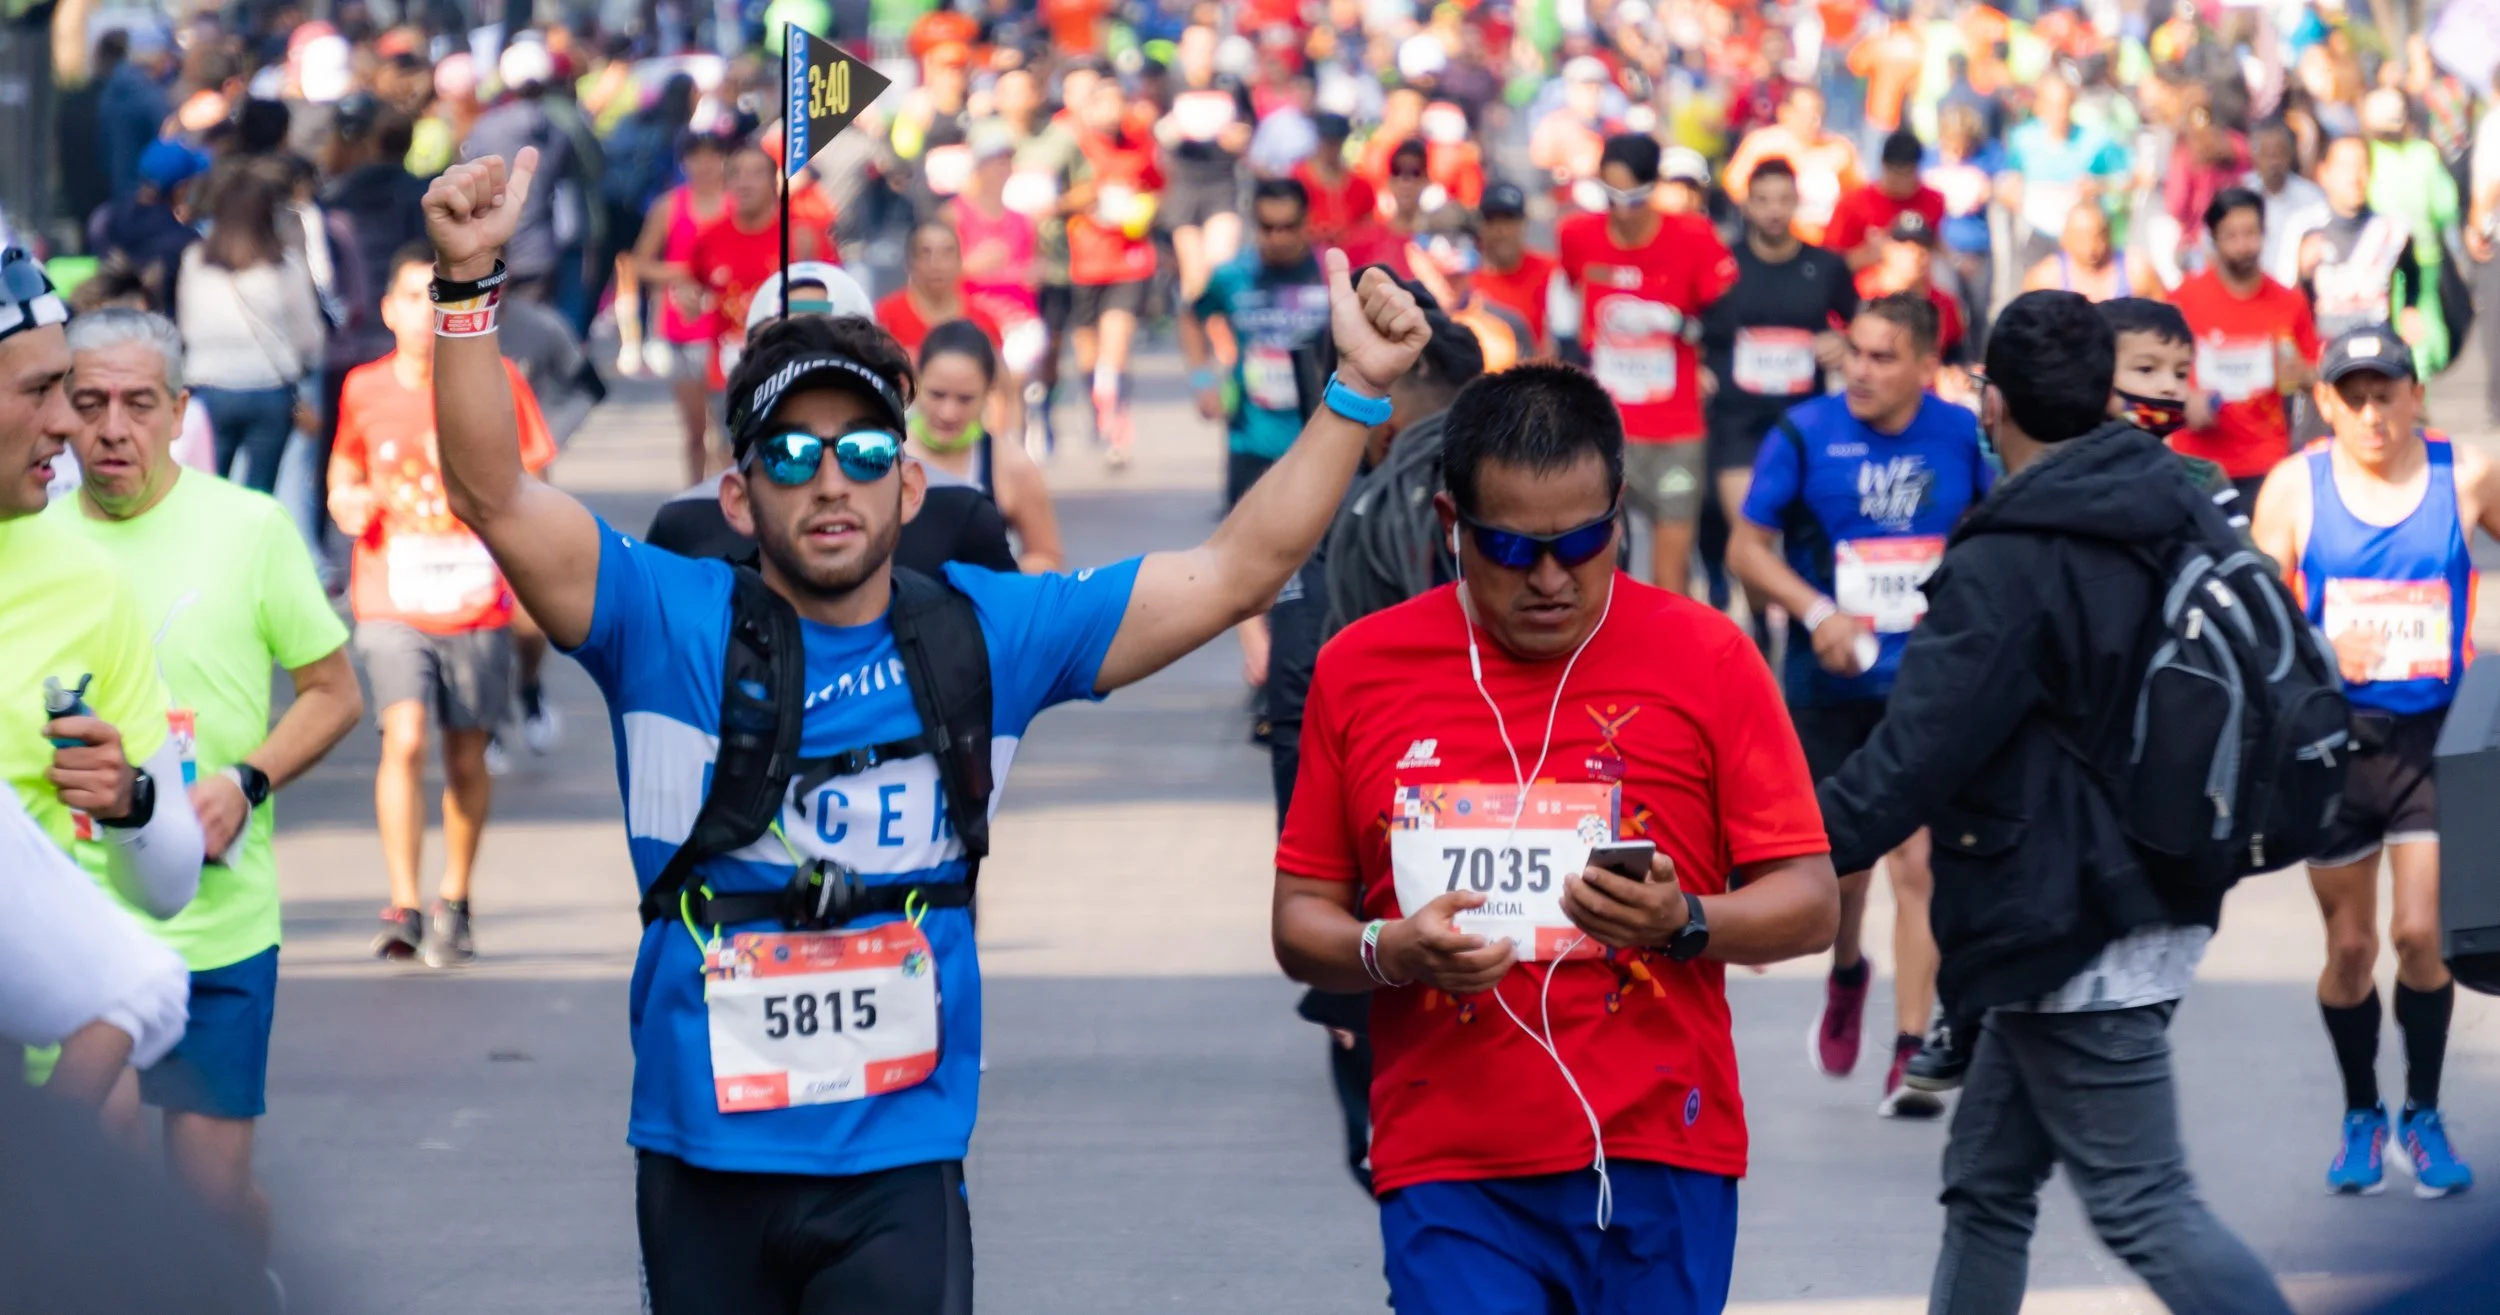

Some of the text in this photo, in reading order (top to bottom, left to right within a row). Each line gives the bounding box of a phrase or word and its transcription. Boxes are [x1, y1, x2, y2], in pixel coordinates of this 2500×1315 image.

[793, 31, 805, 159] GARMIN
[808, 60, 850, 120] 3:40
[1442, 847, 1552, 893] 7035
[763, 987, 878, 1040] 5815
